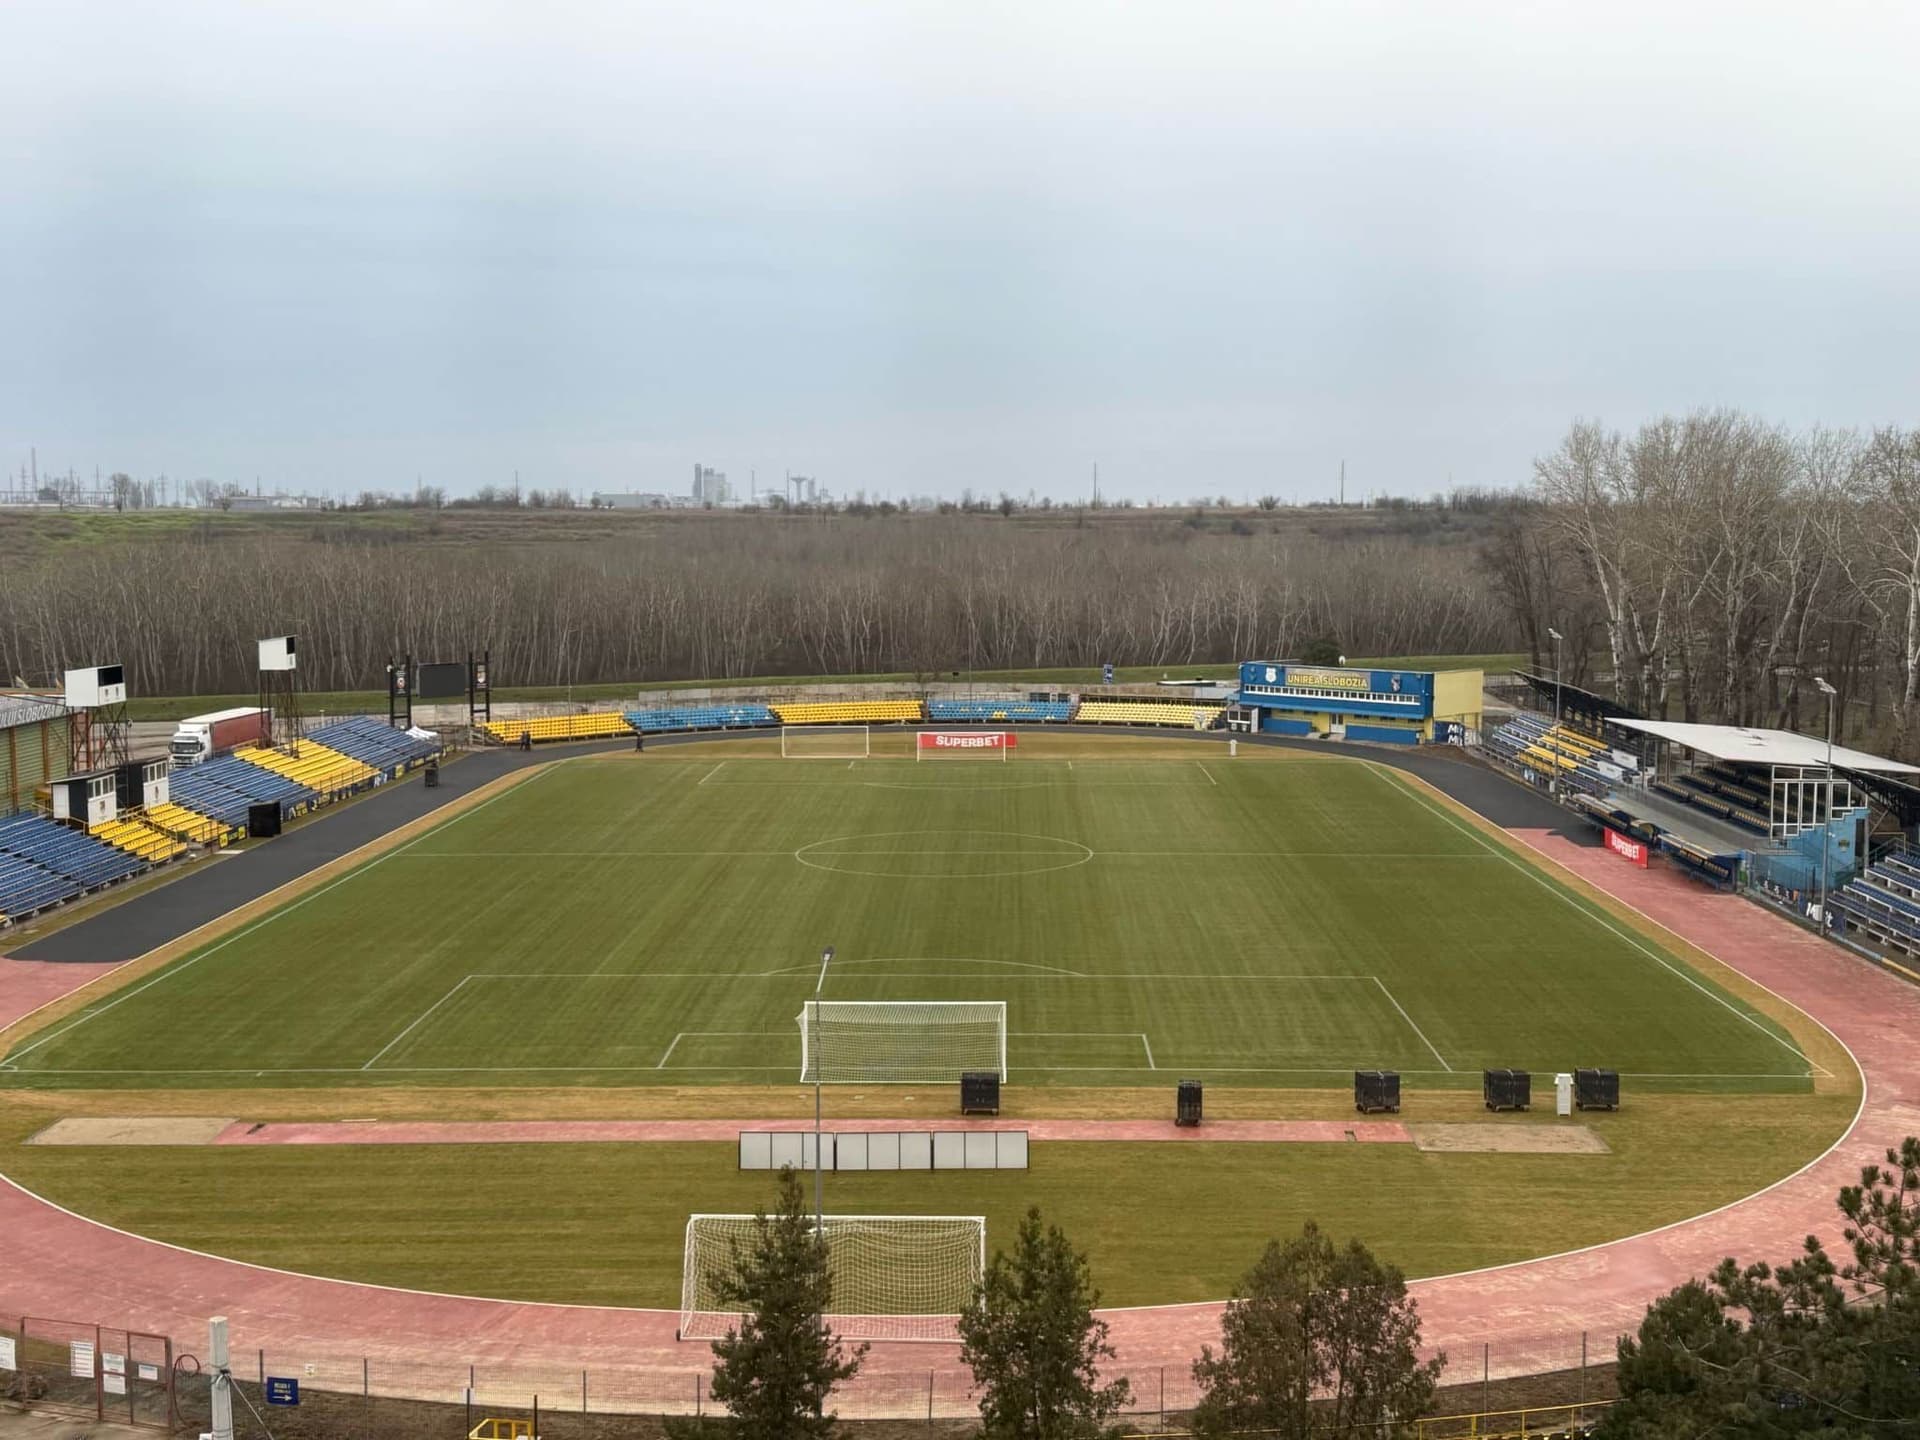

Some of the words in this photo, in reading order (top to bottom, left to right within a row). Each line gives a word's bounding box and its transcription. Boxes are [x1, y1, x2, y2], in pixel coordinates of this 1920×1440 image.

[1288, 674, 1320, 684] UNIREA
[1322, 676, 1367, 687] SLOBOZIA
[936, 735, 999, 747] SUPERBET
